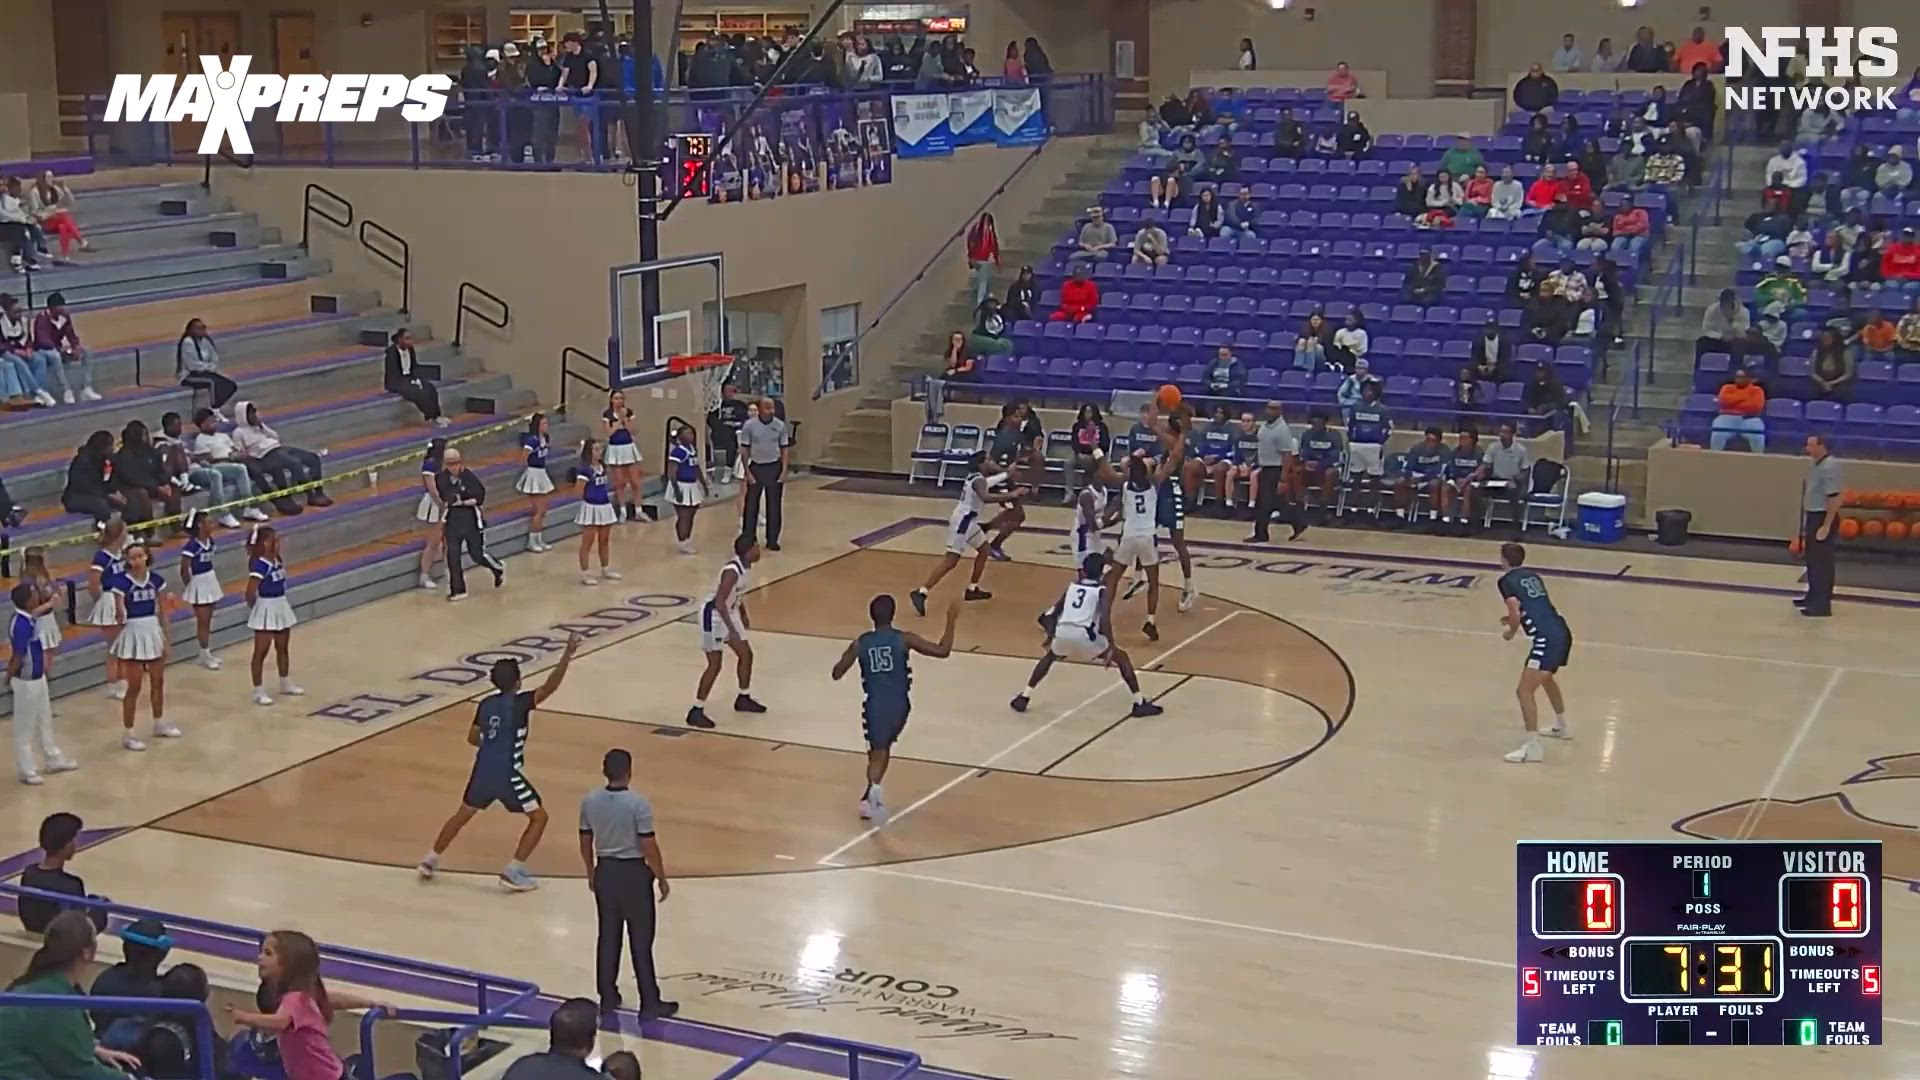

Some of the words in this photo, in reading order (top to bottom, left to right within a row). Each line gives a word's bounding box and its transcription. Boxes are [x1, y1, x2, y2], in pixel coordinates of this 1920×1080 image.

[1135, 495, 1146, 514] 2
[1072, 588, 1087, 609] 3
[307, 693, 431, 724] EL
[411, 594, 692, 687] DORADO
[868, 646, 894, 673] 15
